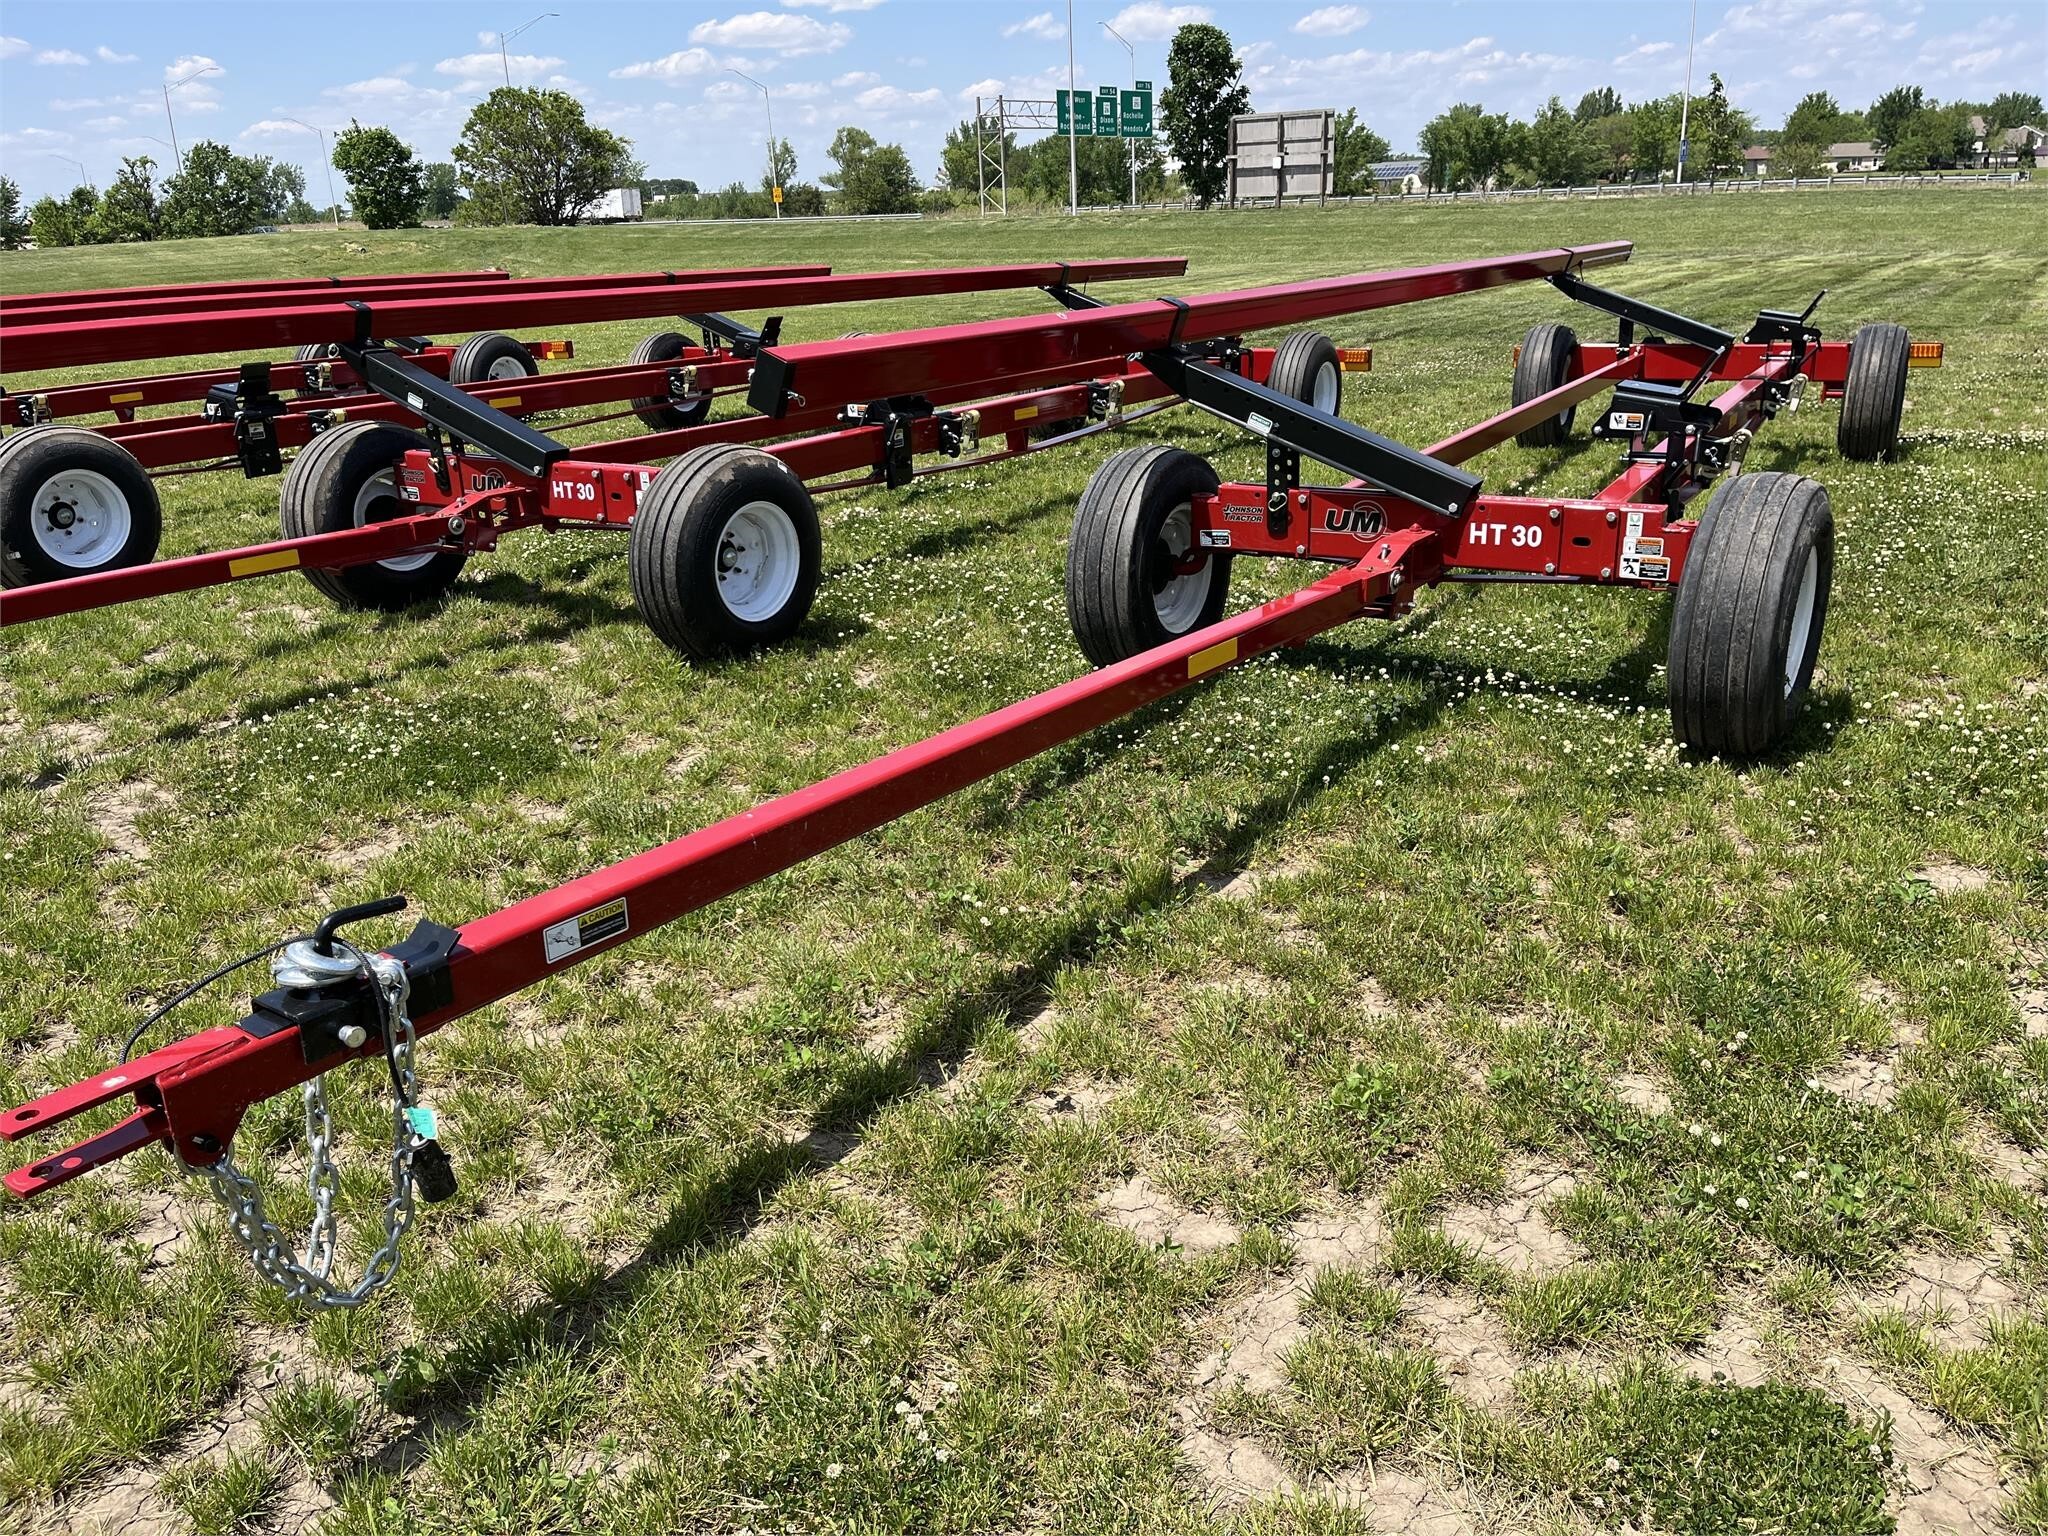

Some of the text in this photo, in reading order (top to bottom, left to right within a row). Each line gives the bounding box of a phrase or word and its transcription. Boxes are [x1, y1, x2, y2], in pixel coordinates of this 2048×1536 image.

[1122, 111, 1144, 119] Rochelle
[472, 474, 504, 492] UM
[552, 480, 595, 501] HT 30
[1223, 503, 1264, 514] JOHNSON
[1224, 512, 1263, 523] TRACTOR
[1325, 508, 1383, 534] UM
[1469, 522, 1542, 548] HT 30
[589, 903, 623, 922] CAUTION
